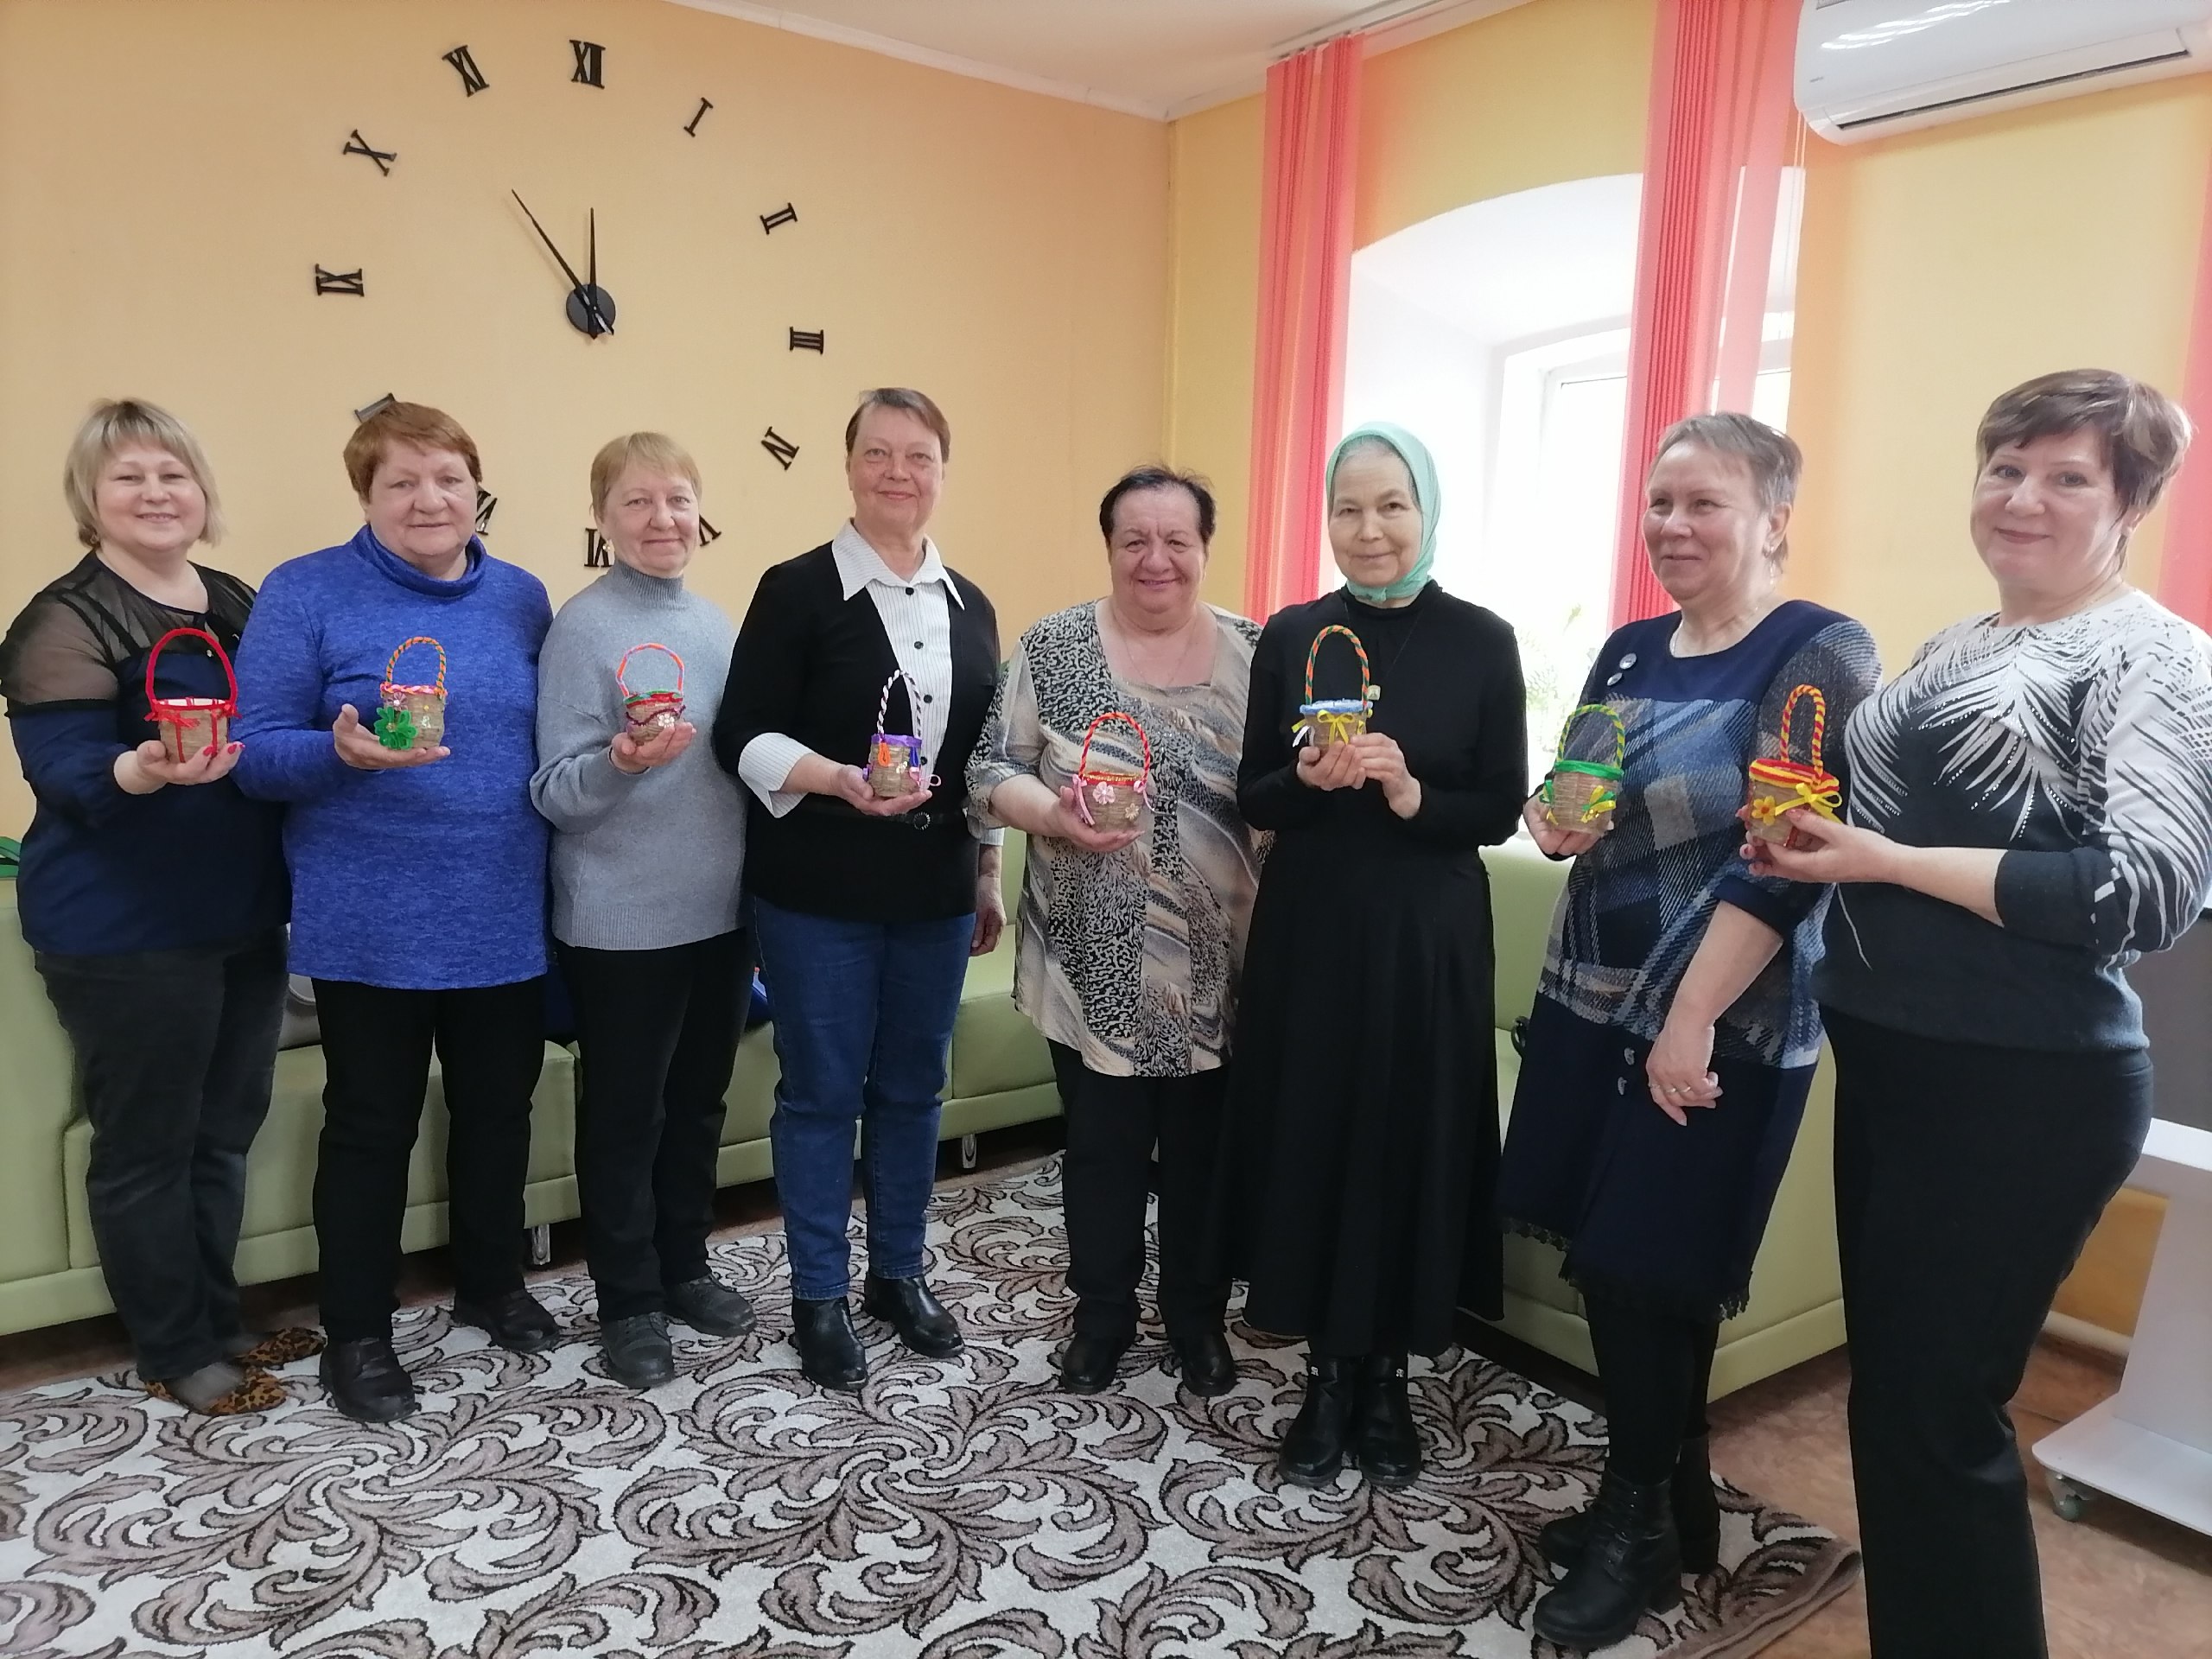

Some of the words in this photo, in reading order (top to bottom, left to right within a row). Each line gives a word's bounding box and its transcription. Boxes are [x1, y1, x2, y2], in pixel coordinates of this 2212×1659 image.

[442, 45, 490, 98] XI
[569, 39, 606, 89] XII
[683, 97, 714, 137] I
[343, 129, 397, 177] X
[760, 201, 798, 235] II
[315, 264, 365, 297] IX
[789, 327, 824, 355] III
[760, 426, 800, 471] IV
